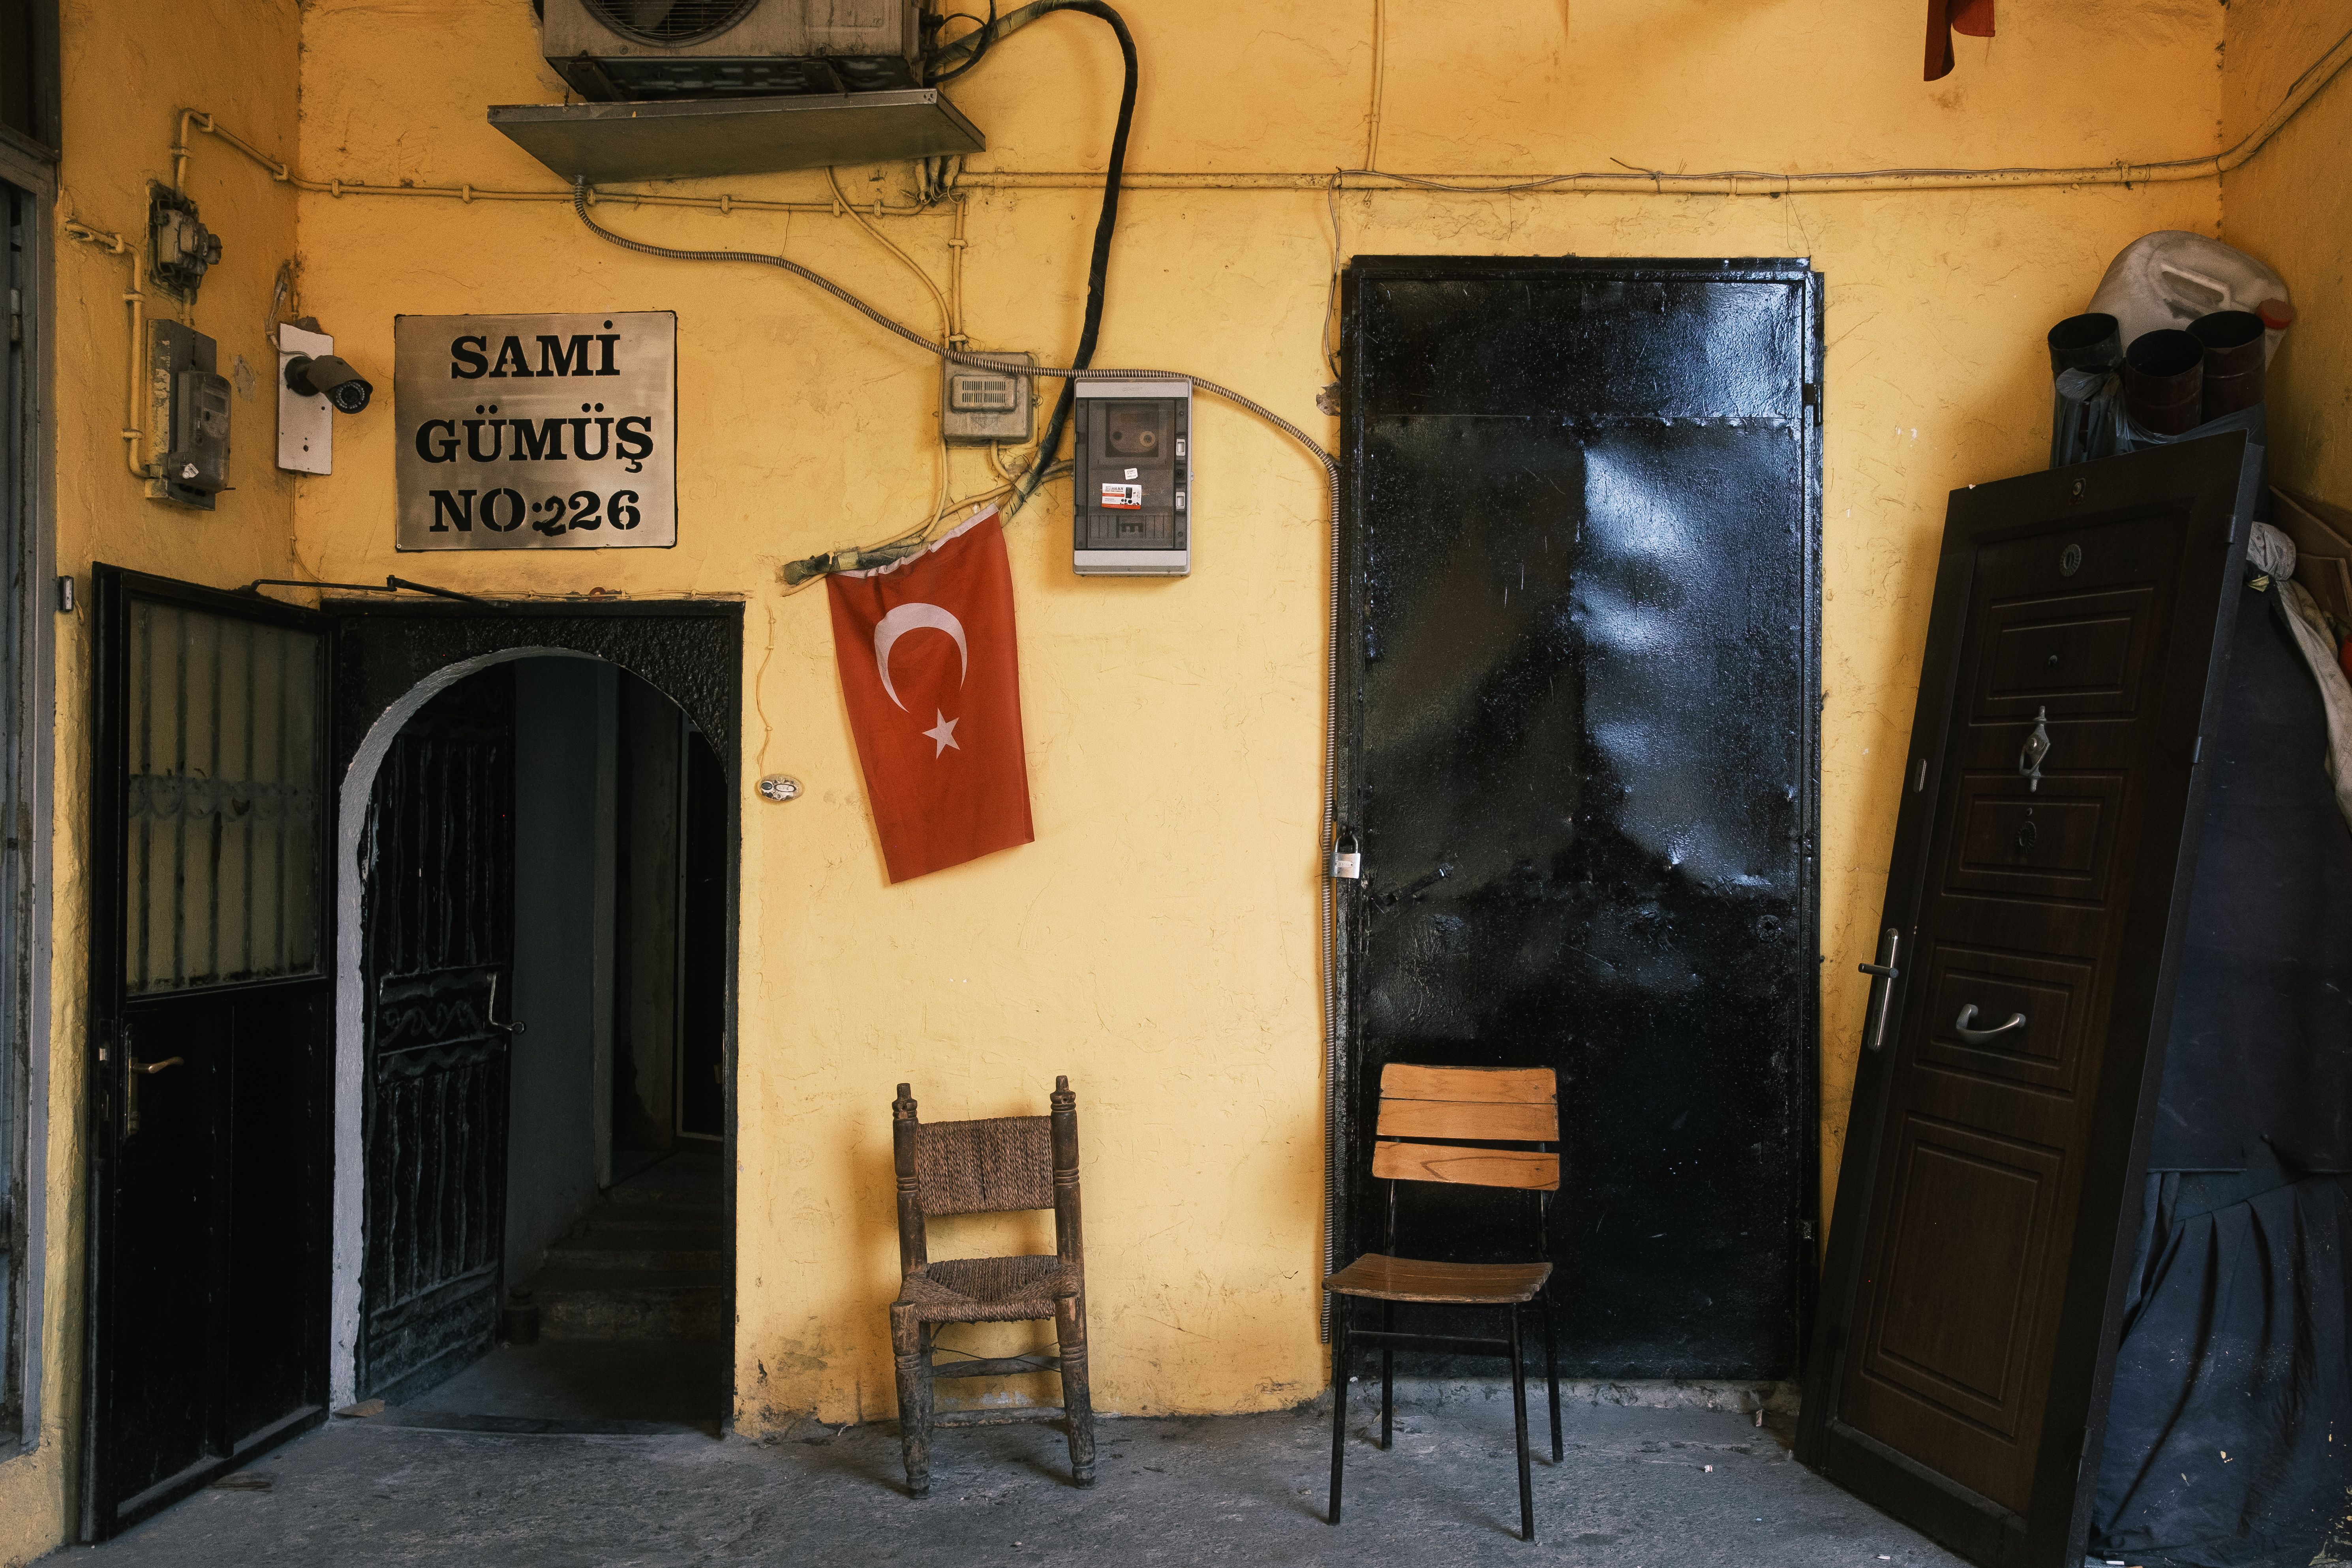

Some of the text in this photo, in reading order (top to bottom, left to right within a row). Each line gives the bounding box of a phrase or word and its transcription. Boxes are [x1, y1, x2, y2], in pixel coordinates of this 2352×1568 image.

[451, 320, 620, 379] SAMİ
[415, 402, 653, 473] GÜMÜŞ
[429, 488, 641, 537] NO:226
